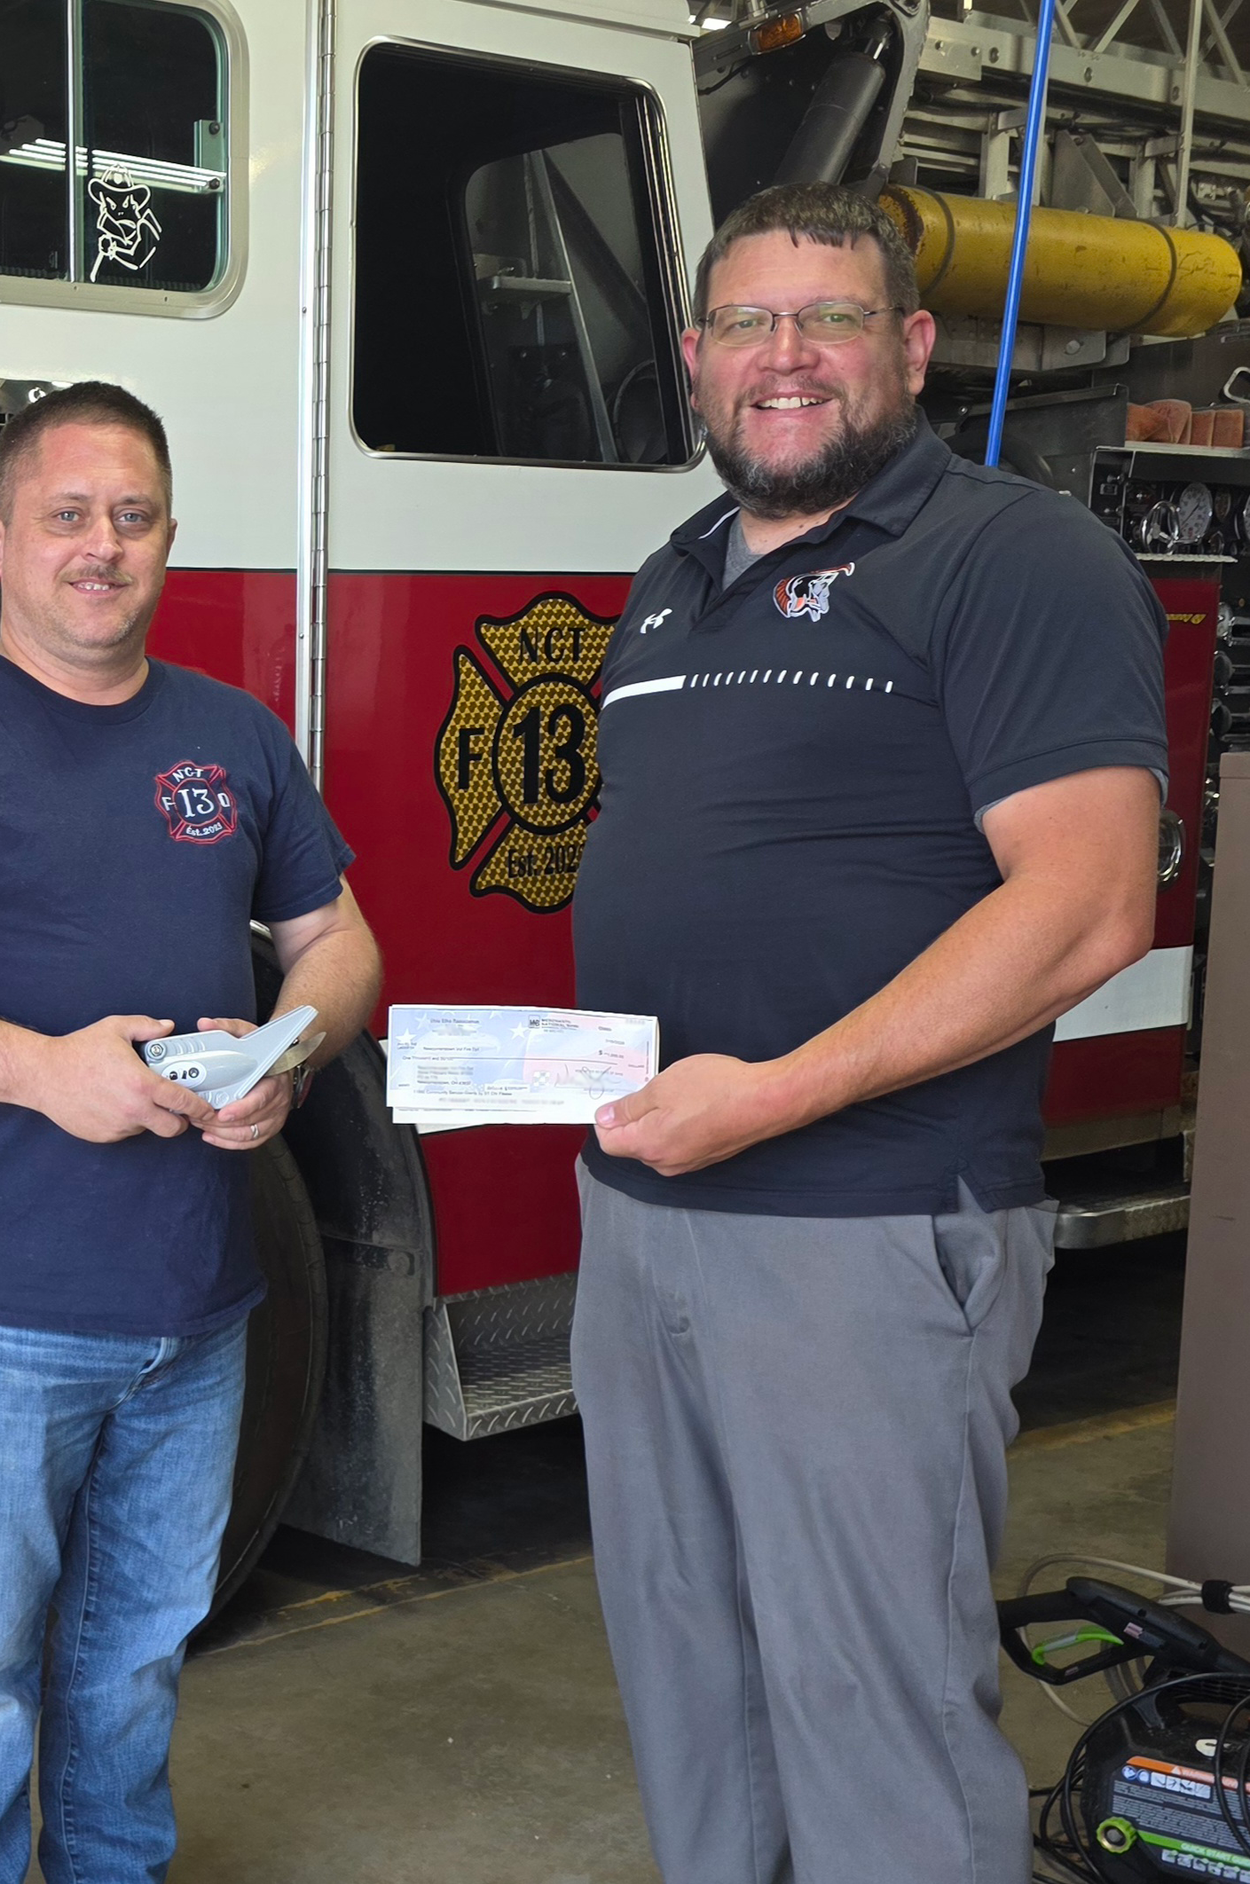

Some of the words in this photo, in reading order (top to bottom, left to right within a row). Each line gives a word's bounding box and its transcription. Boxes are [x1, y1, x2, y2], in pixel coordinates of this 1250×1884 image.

[518, 626, 586, 665] NCT
[458, 727, 485, 791] F
[513, 703, 586, 804] 13
[173, 767, 203, 782] NCT
[162, 797, 175, 811] F
[179, 788, 214, 817] 13
